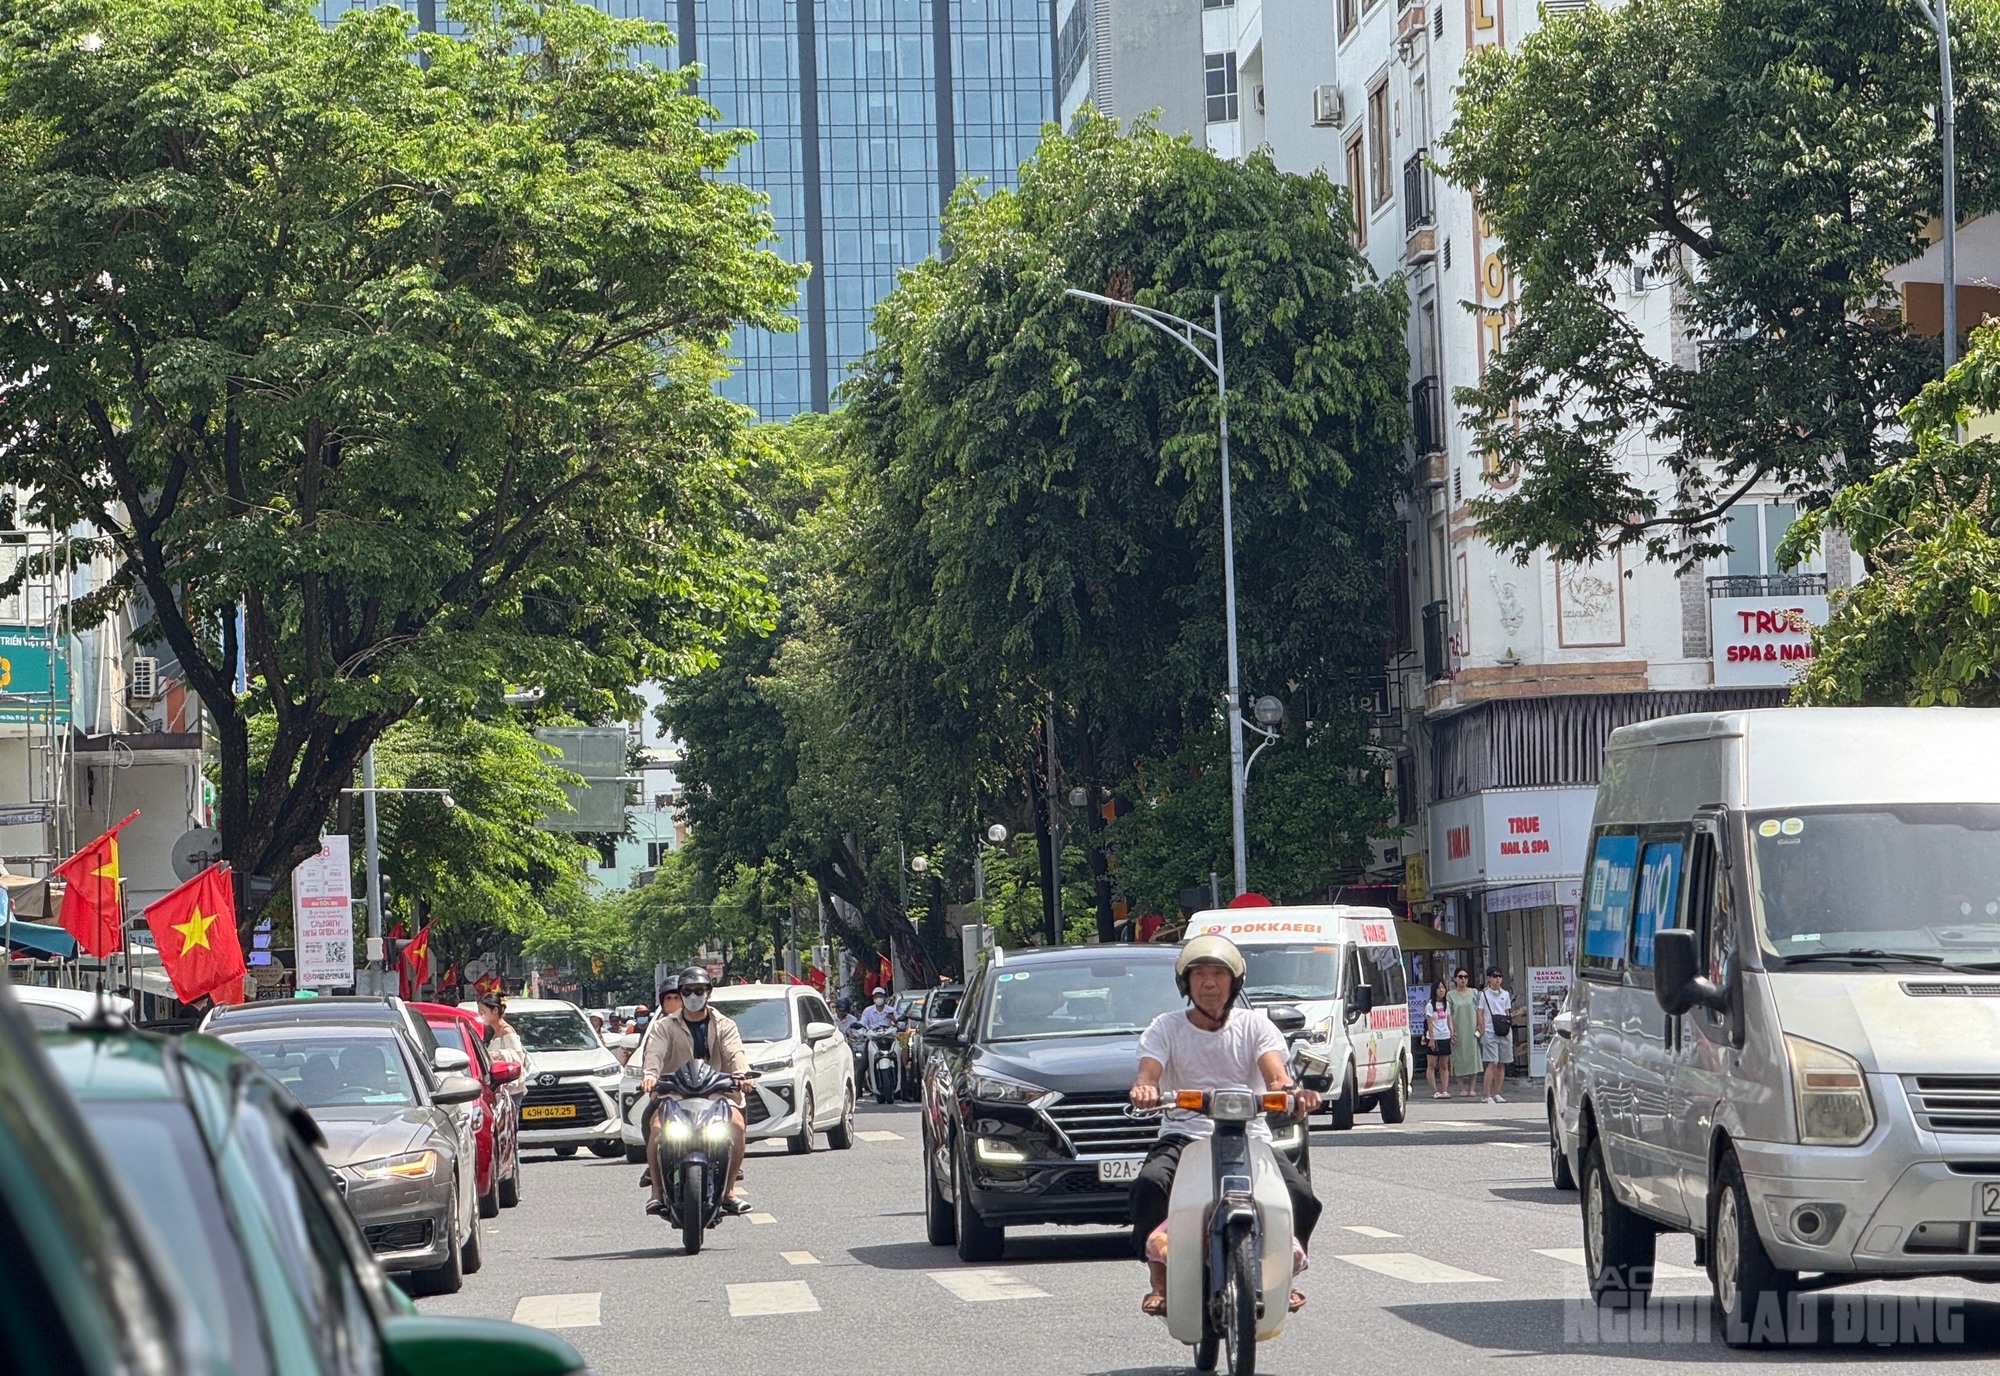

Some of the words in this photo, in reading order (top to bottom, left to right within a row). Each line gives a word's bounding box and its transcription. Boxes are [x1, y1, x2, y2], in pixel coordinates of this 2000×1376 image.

[1737, 607, 1804, 634] TRUE
[1727, 645, 1761, 662] SPA
[1764, 643, 1777, 661] &
[1508, 816, 1540, 834] TRUE
[1500, 840, 1521, 855] NAIL
[1522, 840, 1530, 853] &
[1531, 839, 1549, 853] SPA
[1230, 922, 1322, 934] DOKKAEBI
[1103, 1160, 1144, 1178] 92A-
